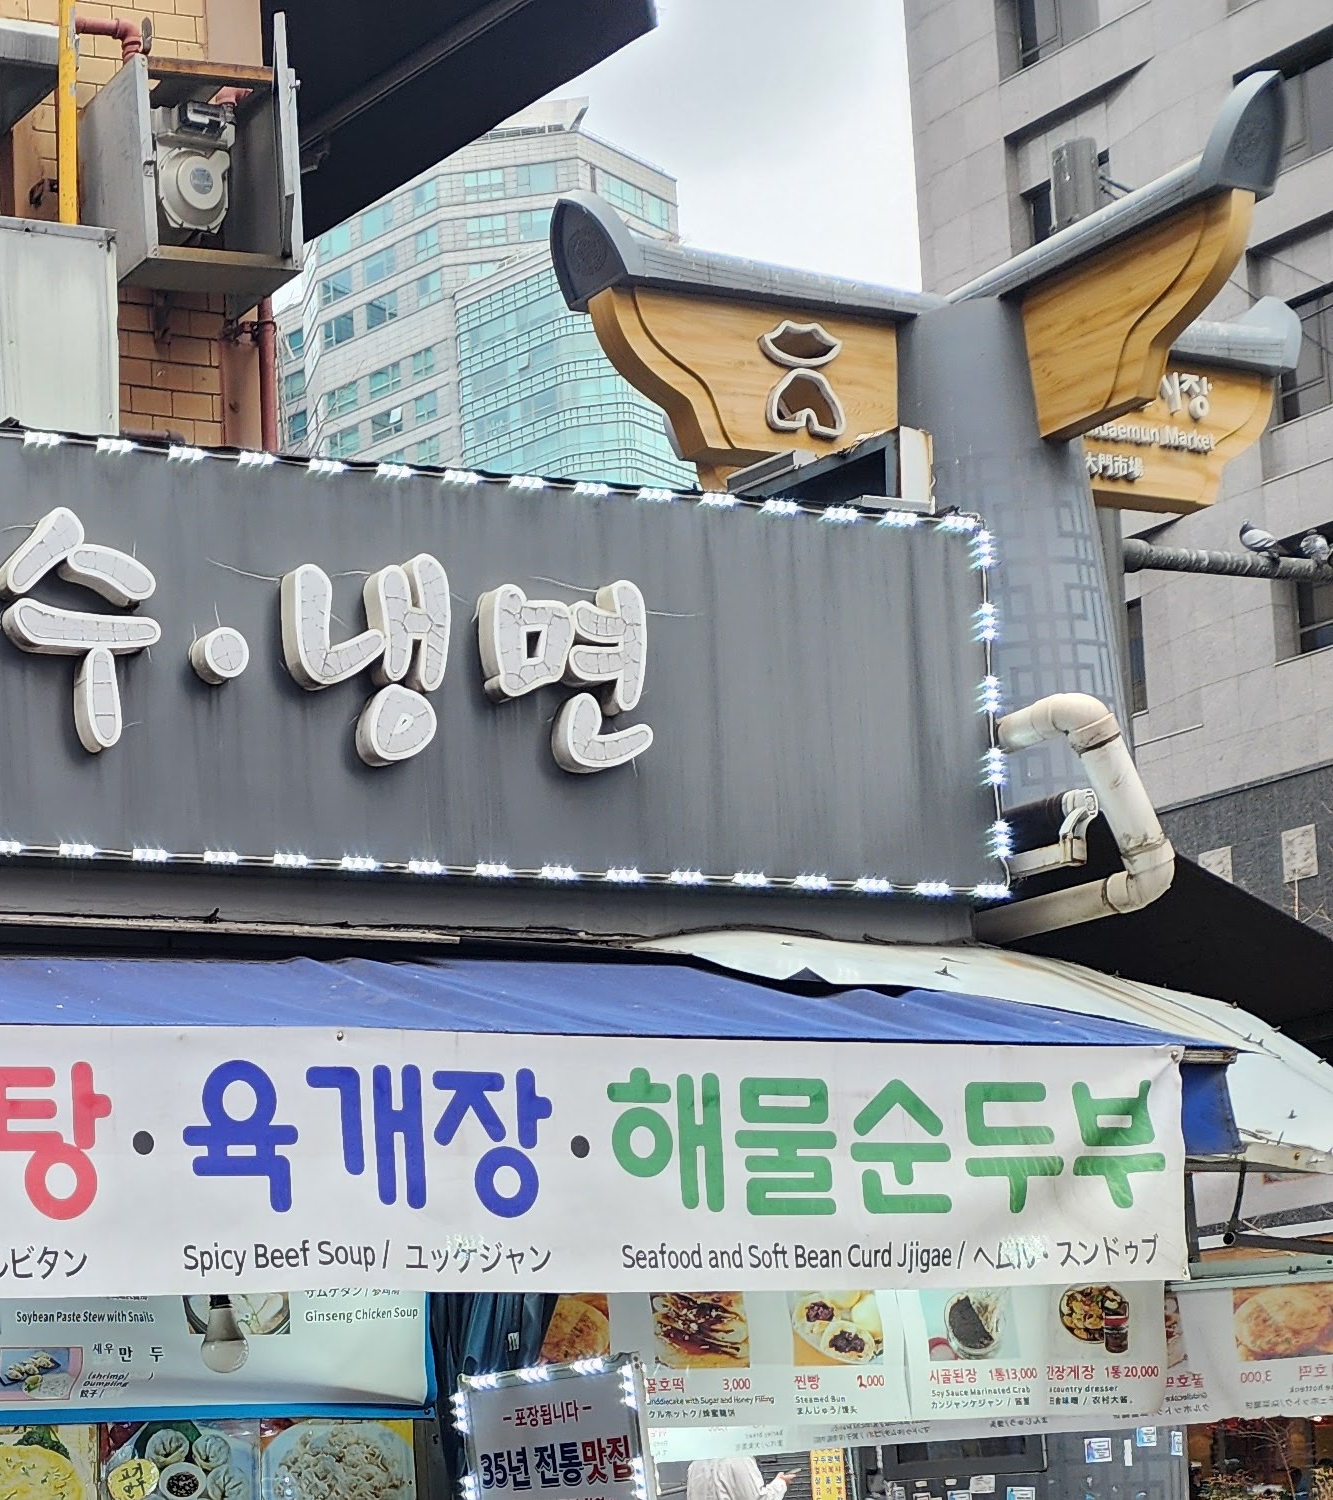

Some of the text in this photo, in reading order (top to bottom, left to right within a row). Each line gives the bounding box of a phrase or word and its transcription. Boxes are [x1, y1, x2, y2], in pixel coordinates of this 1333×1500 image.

[1164, 425, 1215, 453] Market
[279, 552, 655, 776] 냉면
[183, 1059, 552, 1218] 육개장
[606, 1066, 1166, 1216] 해물순두부
[183, 1242, 249, 1277] Spicy
[255, 1240, 312, 1269] Beef
[318, 1239, 376, 1273] Soup
[404, 1238, 552, 1275] ユッケジャン
[621, 1240, 702, 1270] Seafood
[707, 1243, 744, 1269] and
[747, 1241, 787, 1269] Soft
[793, 1241, 841, 1270] Bean
[846, 1241, 892, 1270] Curd
[896, 1241, 950, 1277] Jjigae
[16, 1311, 154, 1325] Soybean Paste Stew with Snails
[306, 1307, 418, 1323] Ginseng Chicken Soup
[930, 1369, 977, 1385] 시골된장
[1104, 1366, 1120, 1380] 1통
[1124, 1366, 1158, 1378] 20,000
[83, 1380, 129, 1388] Dumpling
[723, 1378, 750, 1391] 3,000
[794, 1374, 885, 1390] 찐빵 2,000
[946, 1388, 968, 1396] Sauce
[1013, 1386, 1030, 1394] Crab
[480, 1447, 532, 1490] 35년
